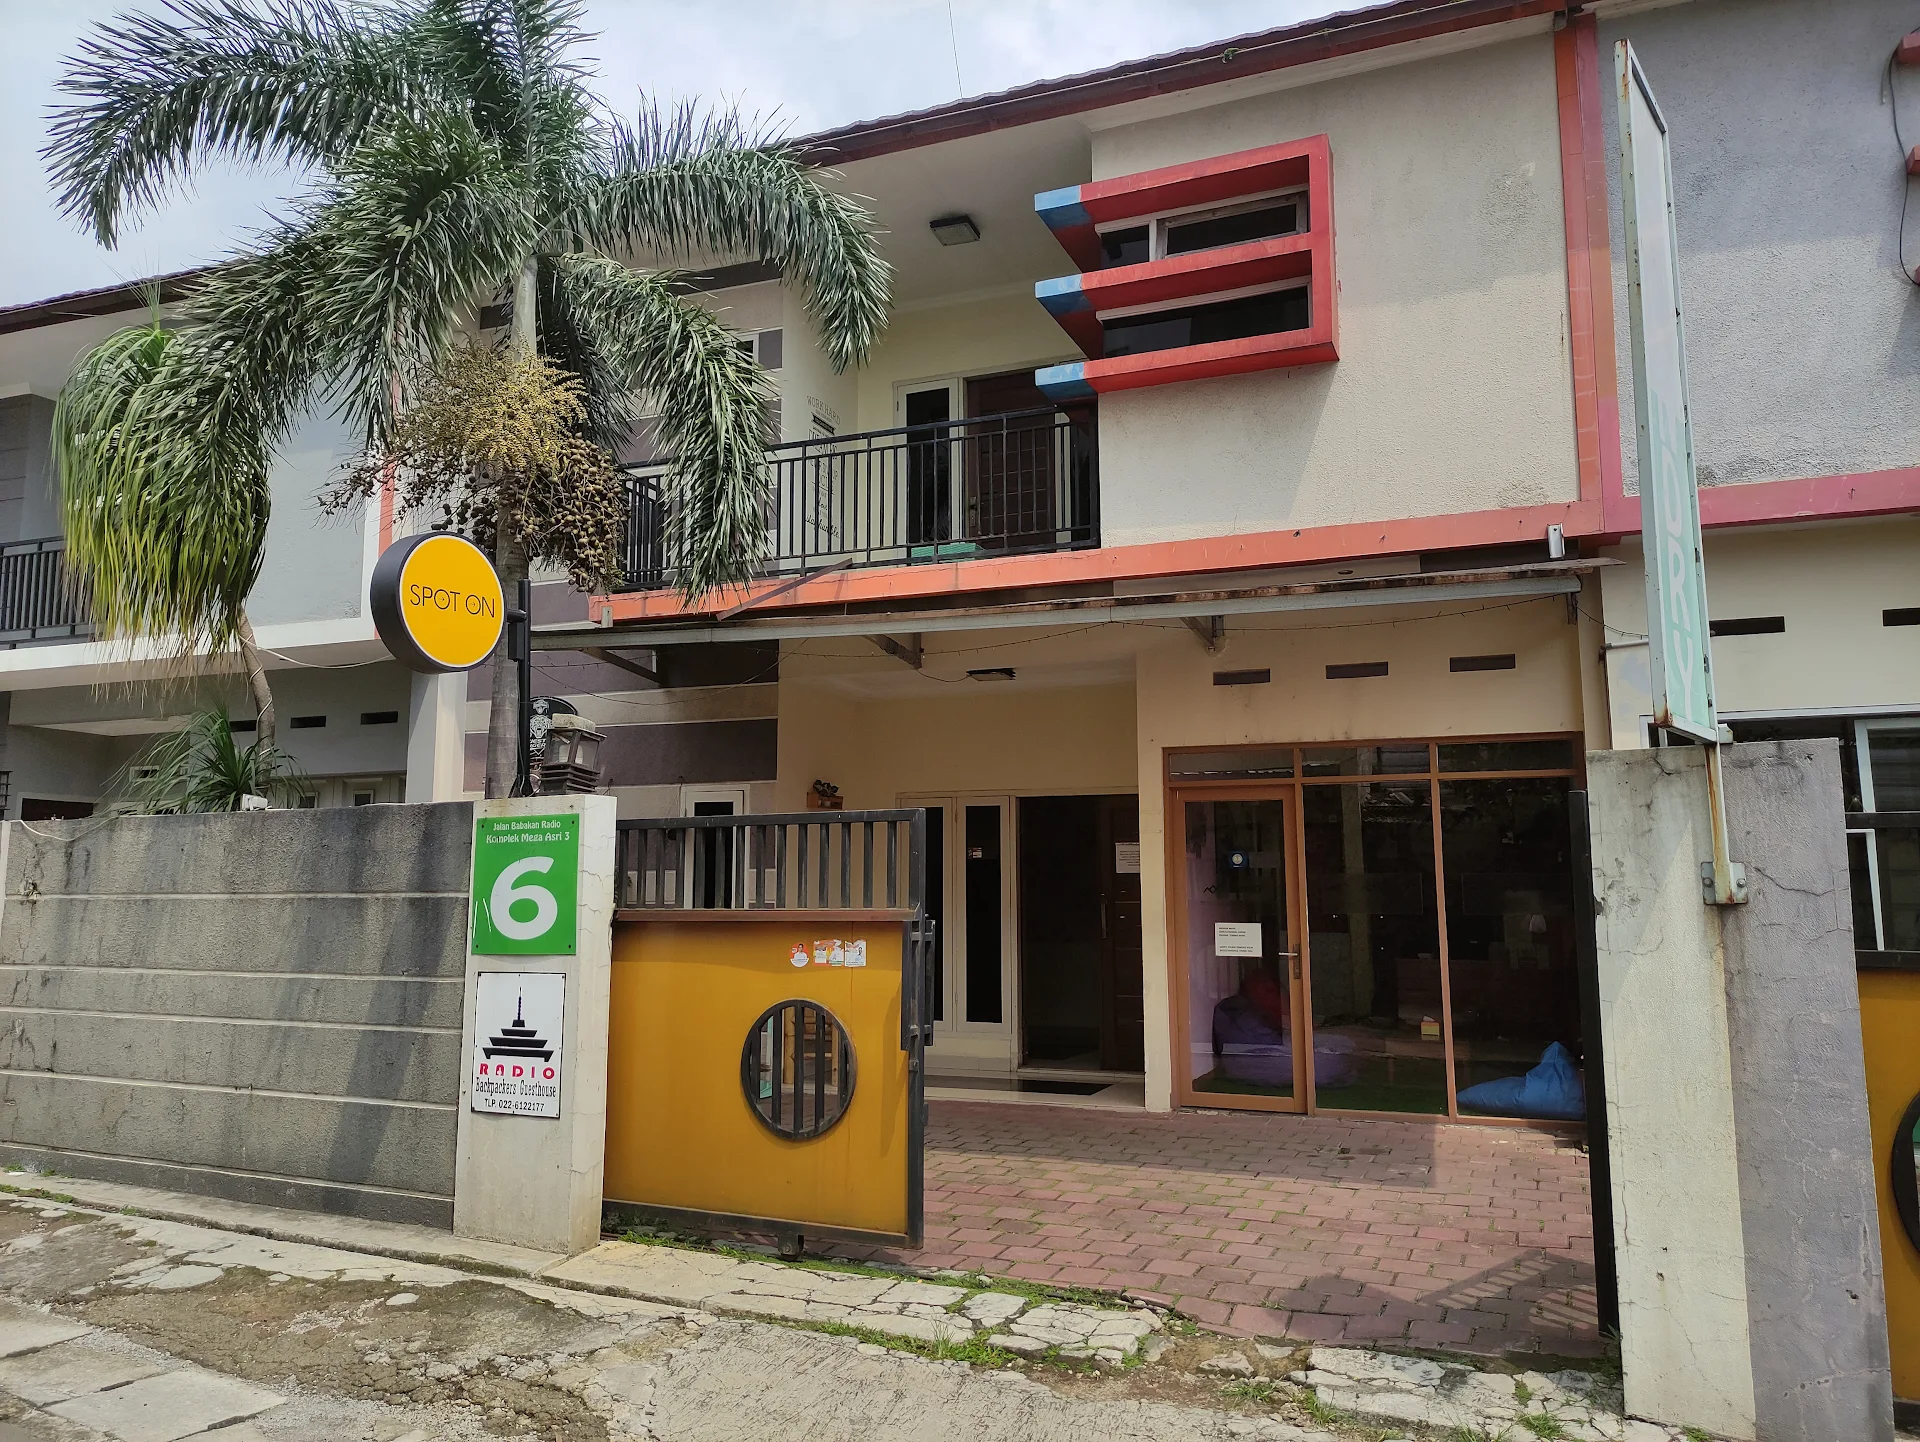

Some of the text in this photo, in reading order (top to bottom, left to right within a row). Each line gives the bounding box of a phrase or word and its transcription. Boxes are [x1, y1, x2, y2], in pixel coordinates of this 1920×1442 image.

[410, 584, 495, 618] SPOT ON
[493, 820, 561, 831] Jalan Babakan Radio
[486, 831, 570, 844] Komplek Mega Asri 3
[490, 856, 558, 941] 6
[479, 1063, 555, 1080] RADIO
[475, 1076, 557, 1098] Backpackers Guesthouse
[498, 1099, 545, 1112] 022-6122177
